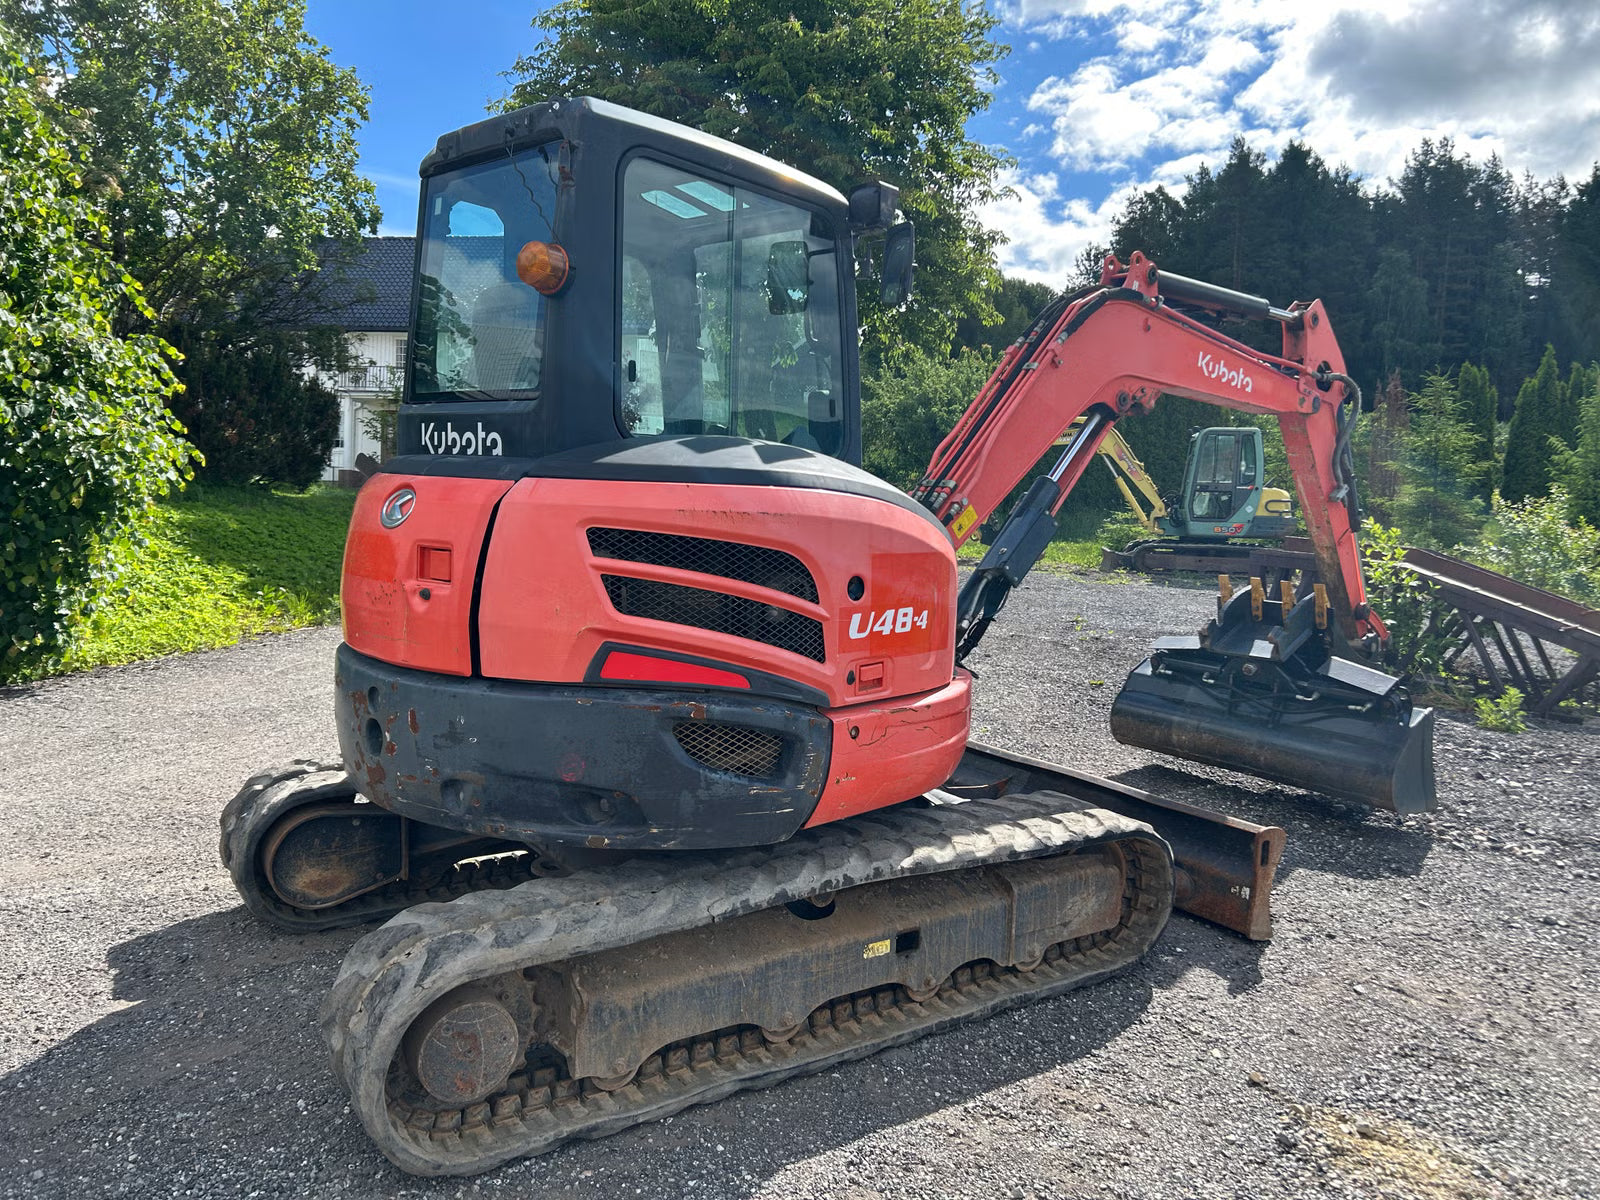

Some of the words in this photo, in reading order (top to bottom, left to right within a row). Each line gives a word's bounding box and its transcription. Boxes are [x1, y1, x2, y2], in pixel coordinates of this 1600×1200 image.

[1198, 351, 1252, 393] Kubota
[421, 422, 502, 456] Kubota
[849, 606, 928, 639] U48-4
